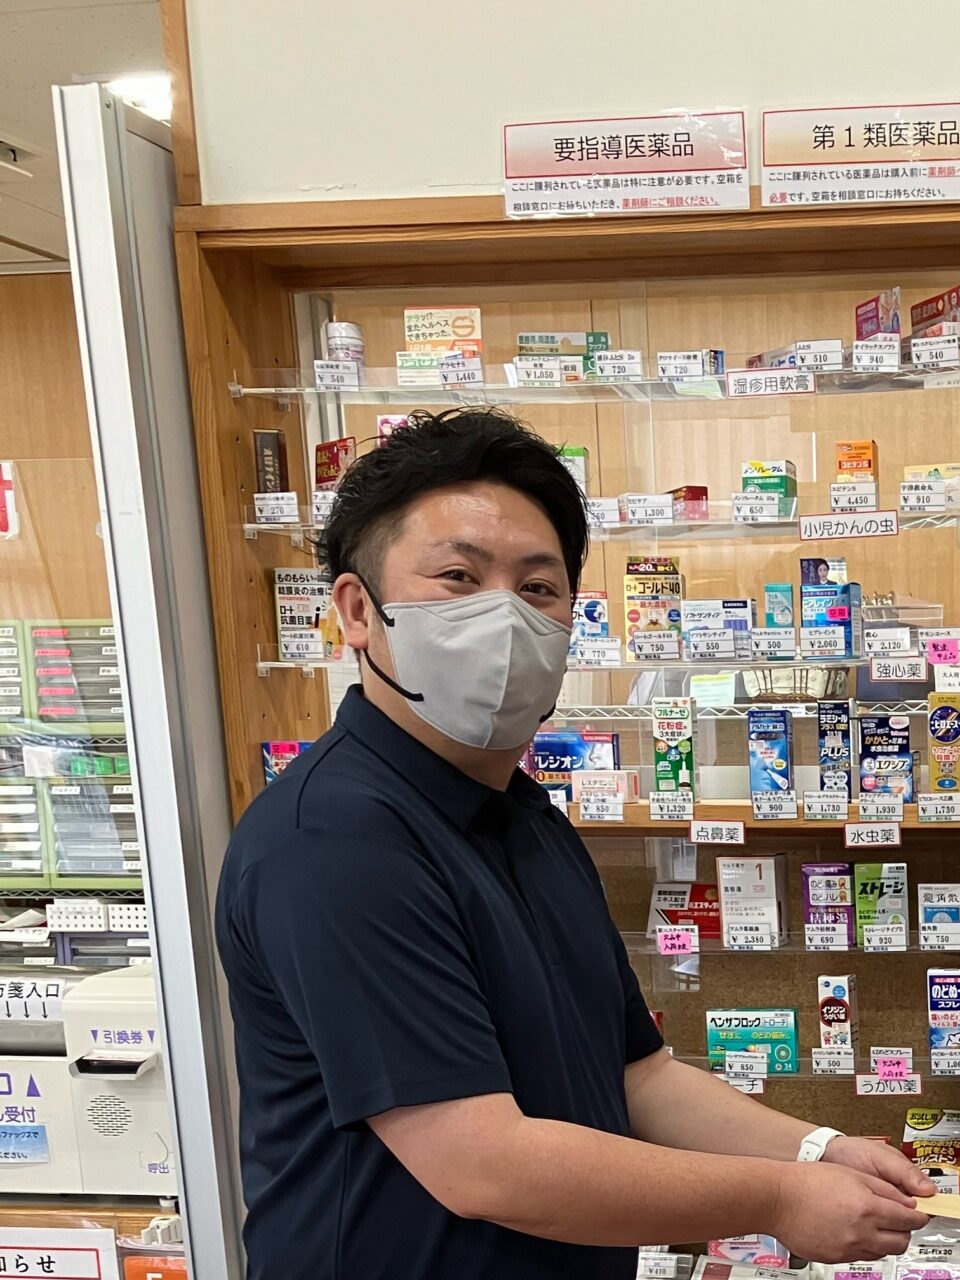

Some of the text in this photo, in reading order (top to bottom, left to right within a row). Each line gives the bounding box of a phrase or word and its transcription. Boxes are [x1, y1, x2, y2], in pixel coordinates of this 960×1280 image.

[554, 132, 694, 162] 要指導医薬品
[734, 376, 809, 395] 湿疹用軟膏
[804, 520, 894, 537] 小児かんの虫
[877, 662, 922, 679] 強心薬
[656, 709, 686, 717] フルナーゼ
[821, 748, 849, 757] PLUS
[696, 827, 740, 841] 点鼻薬
[851, 828, 895, 843] 水虫薬
[756, 863, 763, 880] 1
[858, 881, 905, 896] ストレージ
[103, 1030, 143, 1044] 引換券
[862, 1079, 917, 1093] うがい薬
